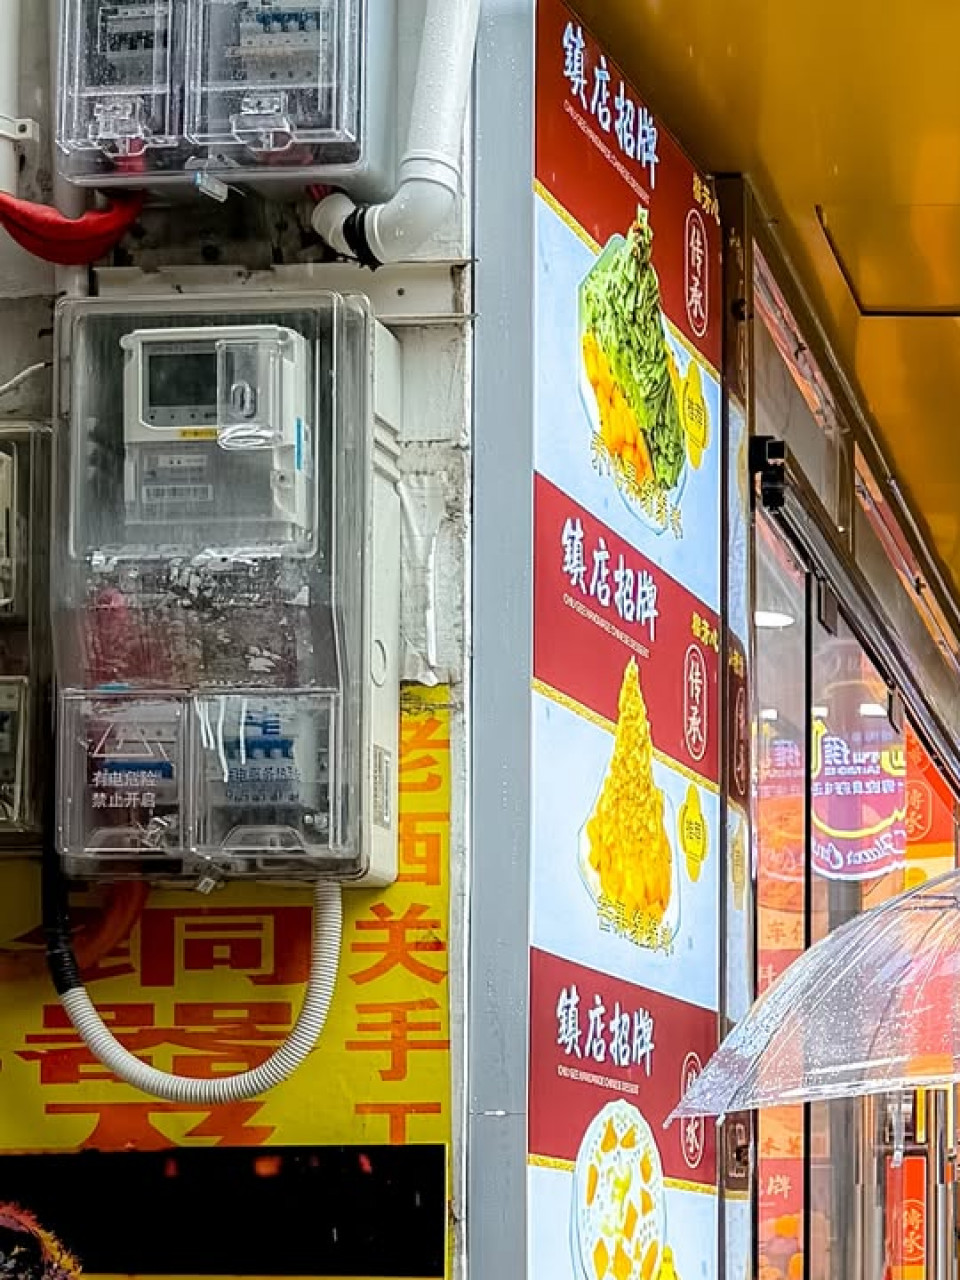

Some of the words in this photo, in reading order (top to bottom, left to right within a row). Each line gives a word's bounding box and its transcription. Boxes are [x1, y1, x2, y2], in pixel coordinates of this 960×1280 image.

[563, 21, 660, 189] 鎮店招牌
[562, 517, 659, 642] 鎮店招牌
[92, 769, 157, 787] 有电危险
[92, 792, 156, 808] 禁止开启
[555, 984, 656, 1077] 鎮店招牌
